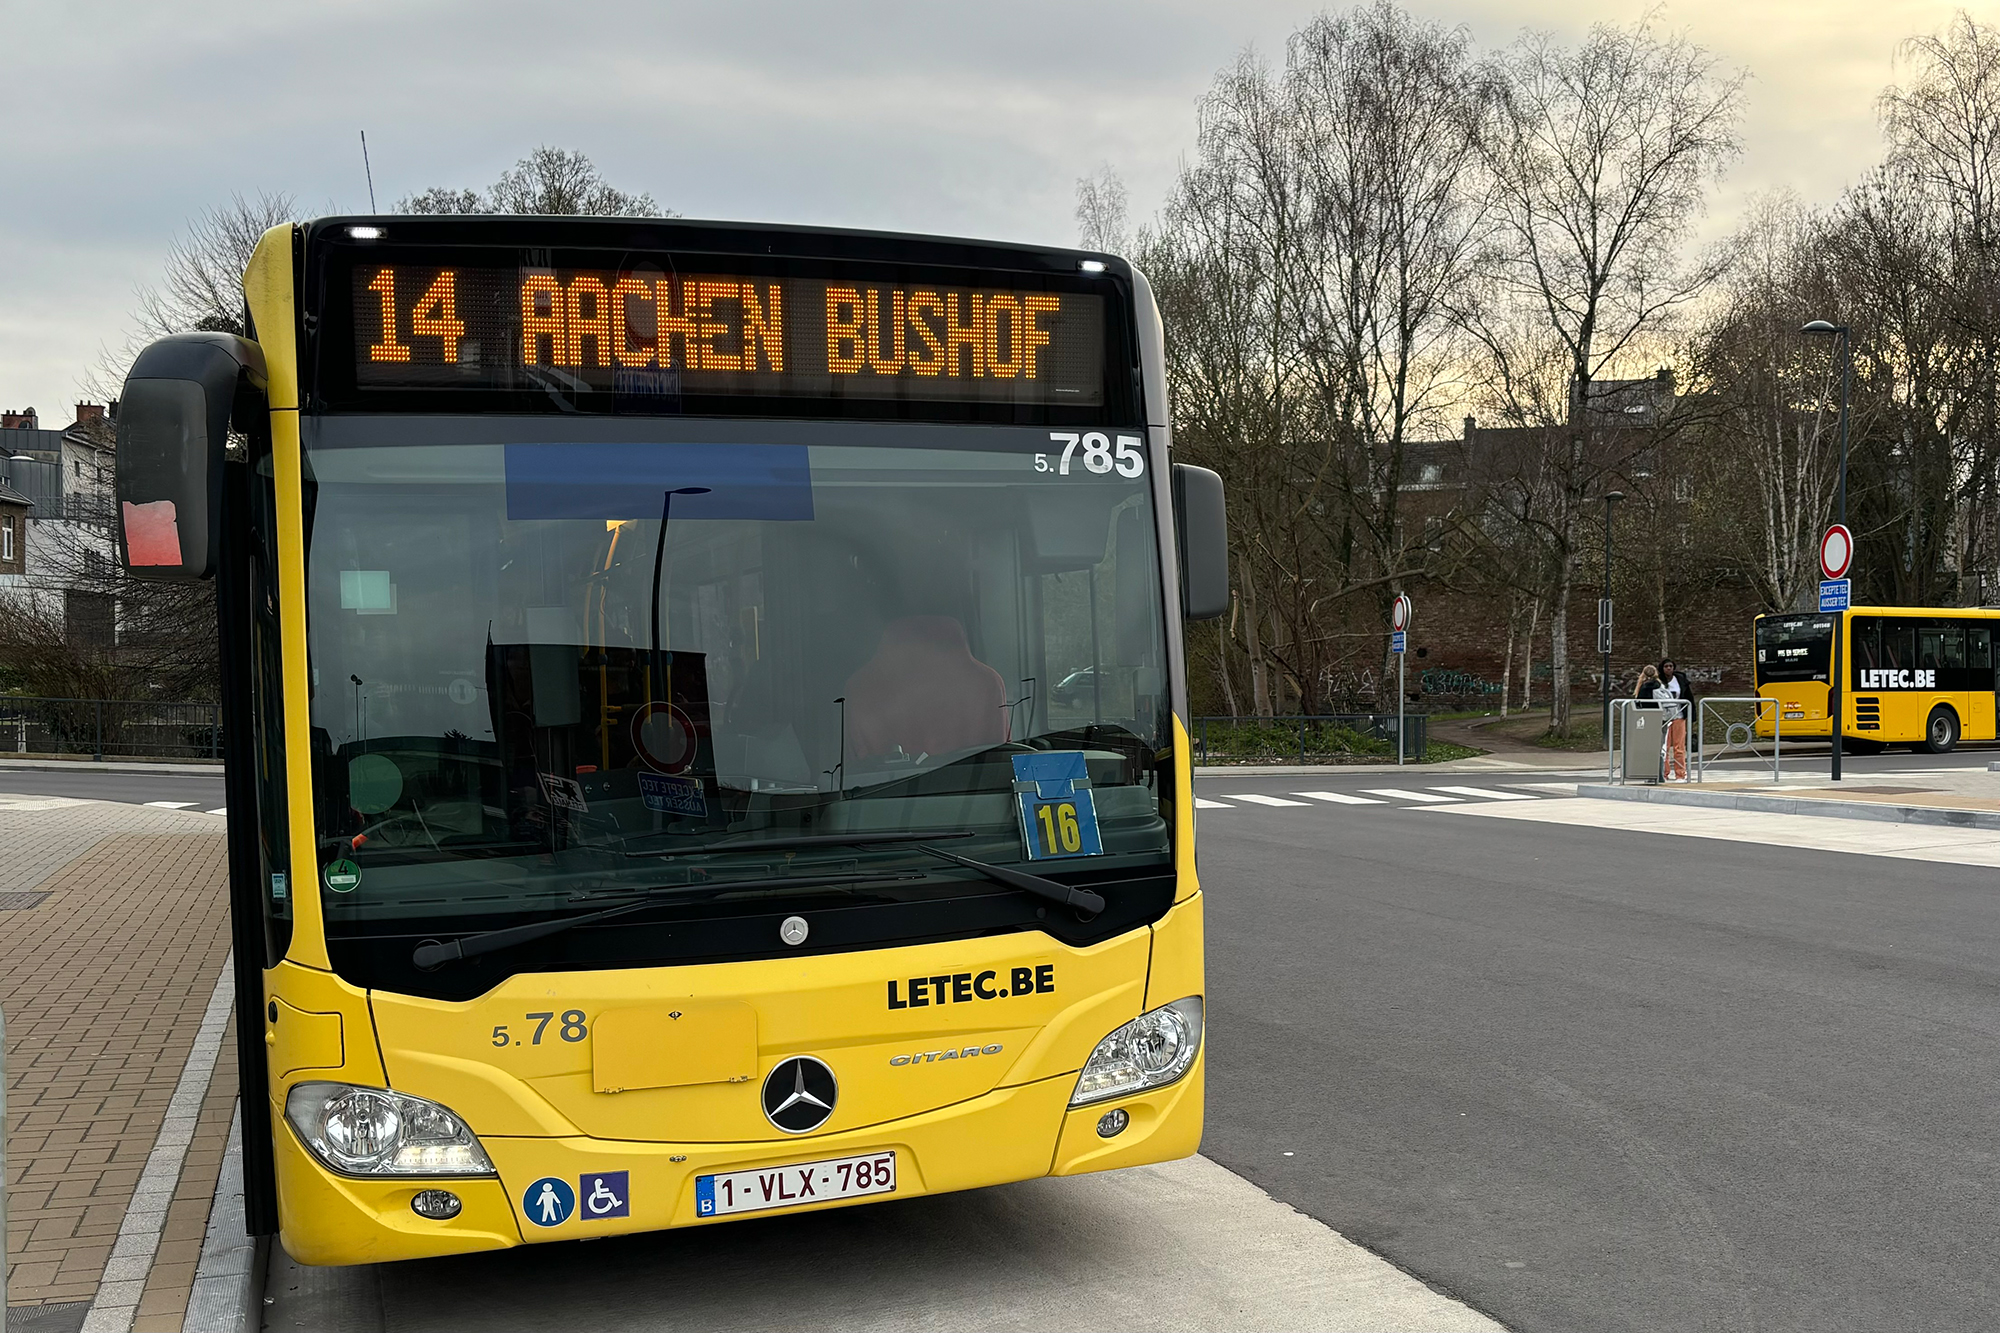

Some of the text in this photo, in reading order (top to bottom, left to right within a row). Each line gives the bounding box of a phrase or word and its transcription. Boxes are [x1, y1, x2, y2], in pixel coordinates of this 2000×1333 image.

[367, 269, 1060, 379] 14 AACHEN BUSHOF
[1034, 431, 1144, 478] 5.785
[1838, 597, 1846, 606] TEC
[1839, 584, 1848, 594] TEC
[1860, 669, 1936, 688] LETEC.BE
[1038, 803, 1081, 854] 16
[338, 860, 348, 875] 4
[887, 964, 1054, 1010] LETEC.BE
[492, 1009, 587, 1047] 5.78
[890, 1043, 1003, 1066] CITARO
[701, 1157, 891, 1213] B 1-VLX-785
